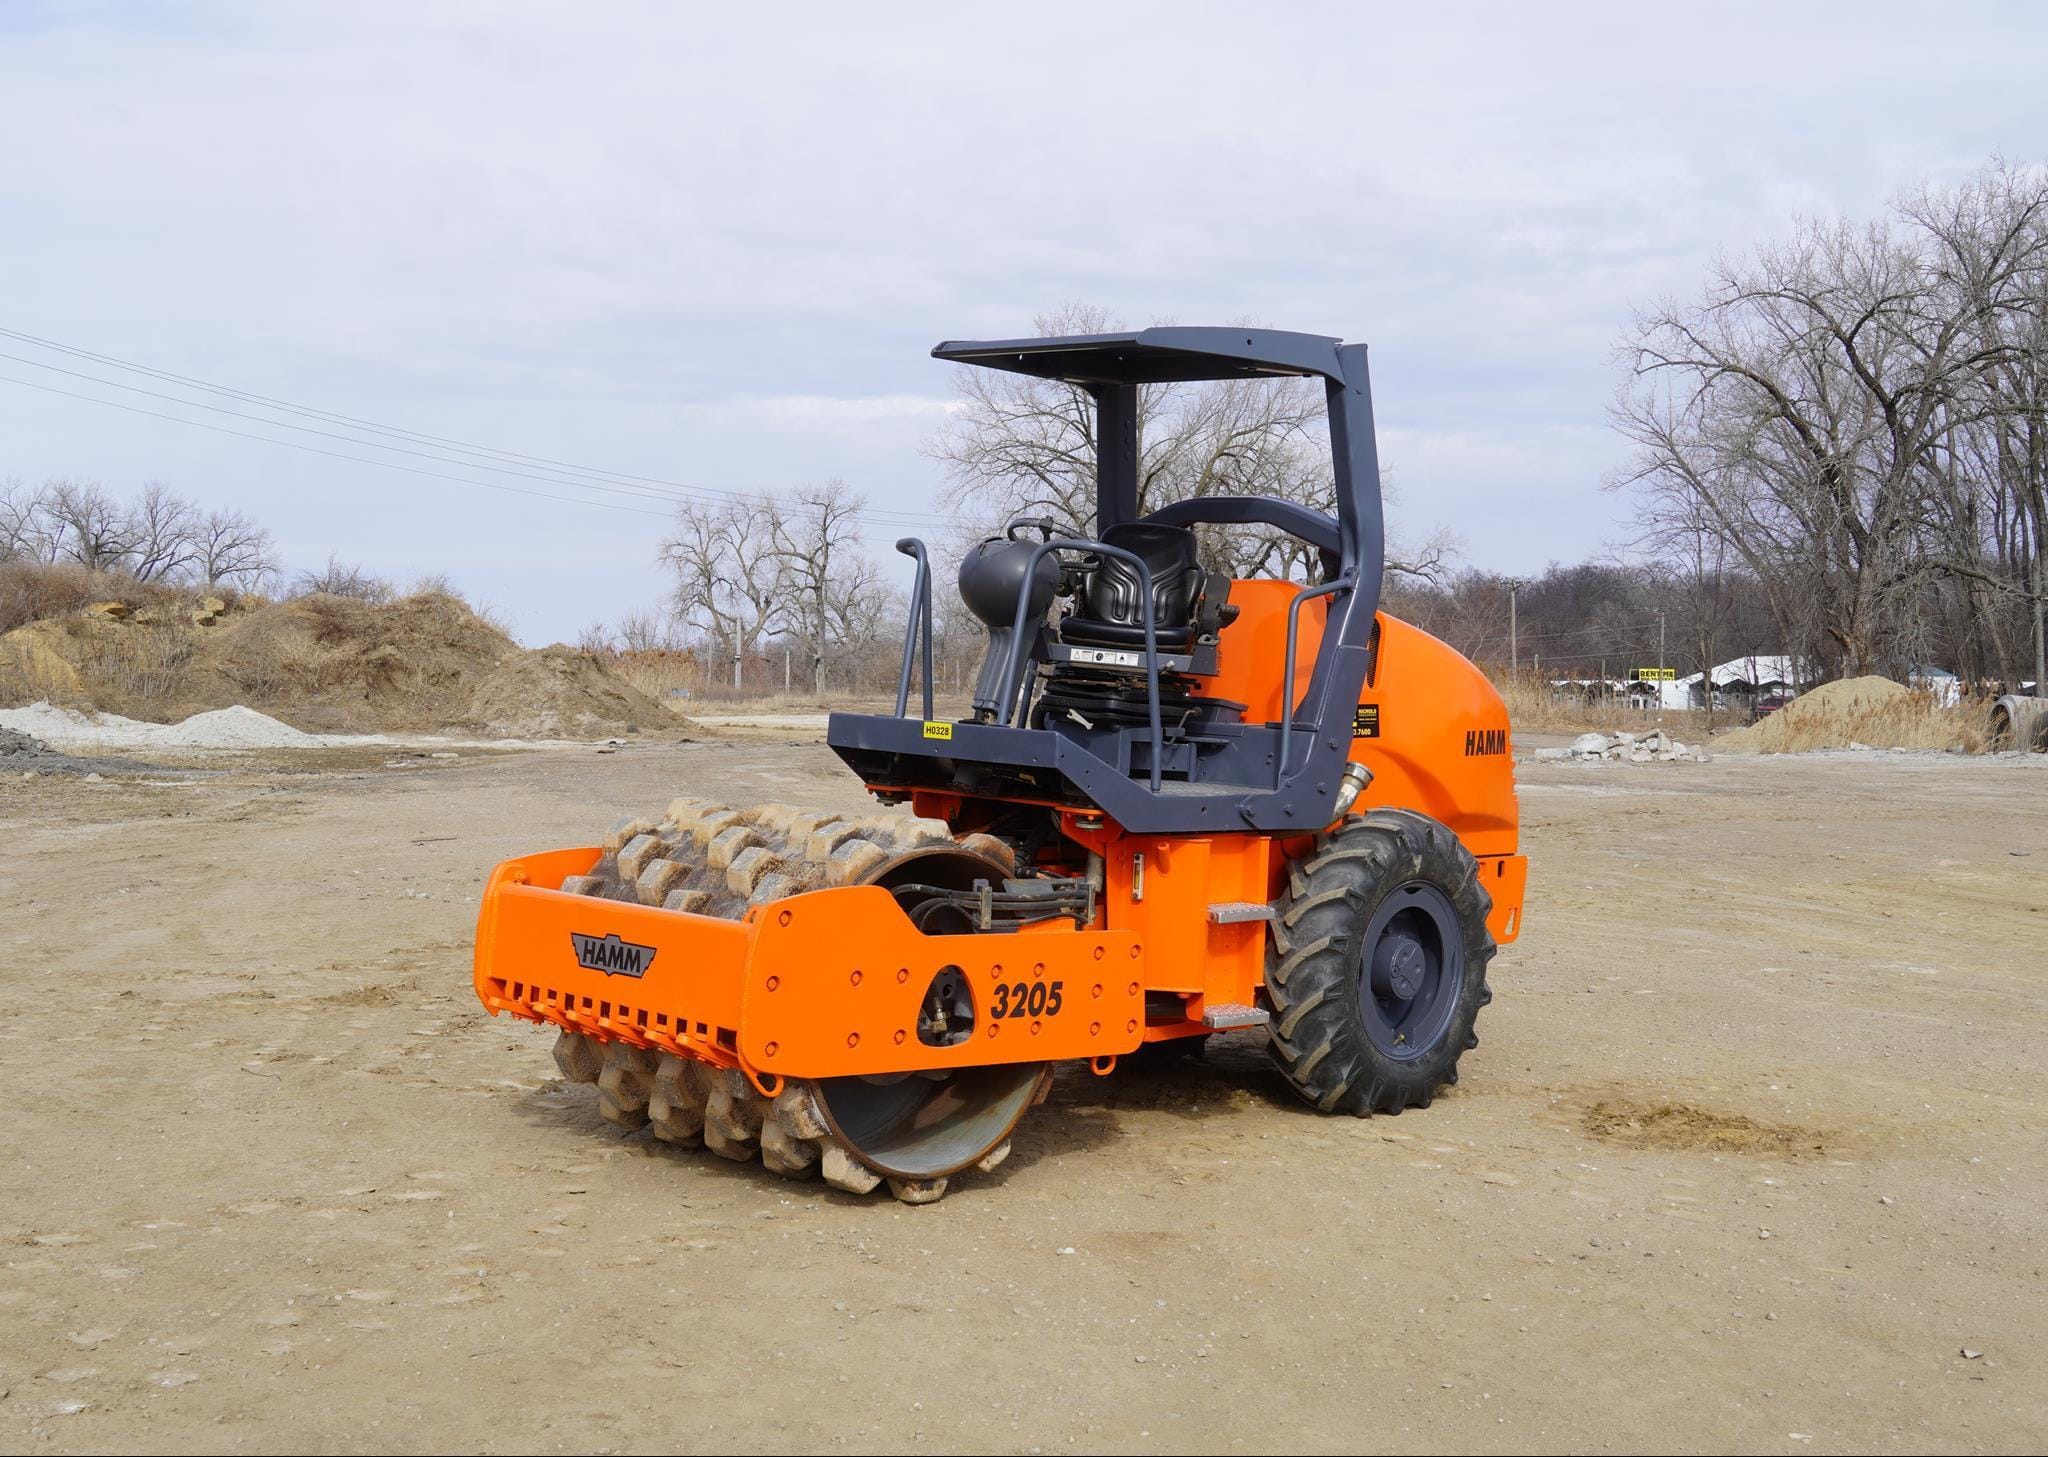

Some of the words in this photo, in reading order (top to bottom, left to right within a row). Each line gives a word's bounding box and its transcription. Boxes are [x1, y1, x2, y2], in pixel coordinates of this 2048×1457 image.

[926, 726, 950, 736] H0328
[1465, 729, 1505, 757] HAMM
[583, 940, 641, 973] HAMM
[991, 979, 1063, 1020] 3205
